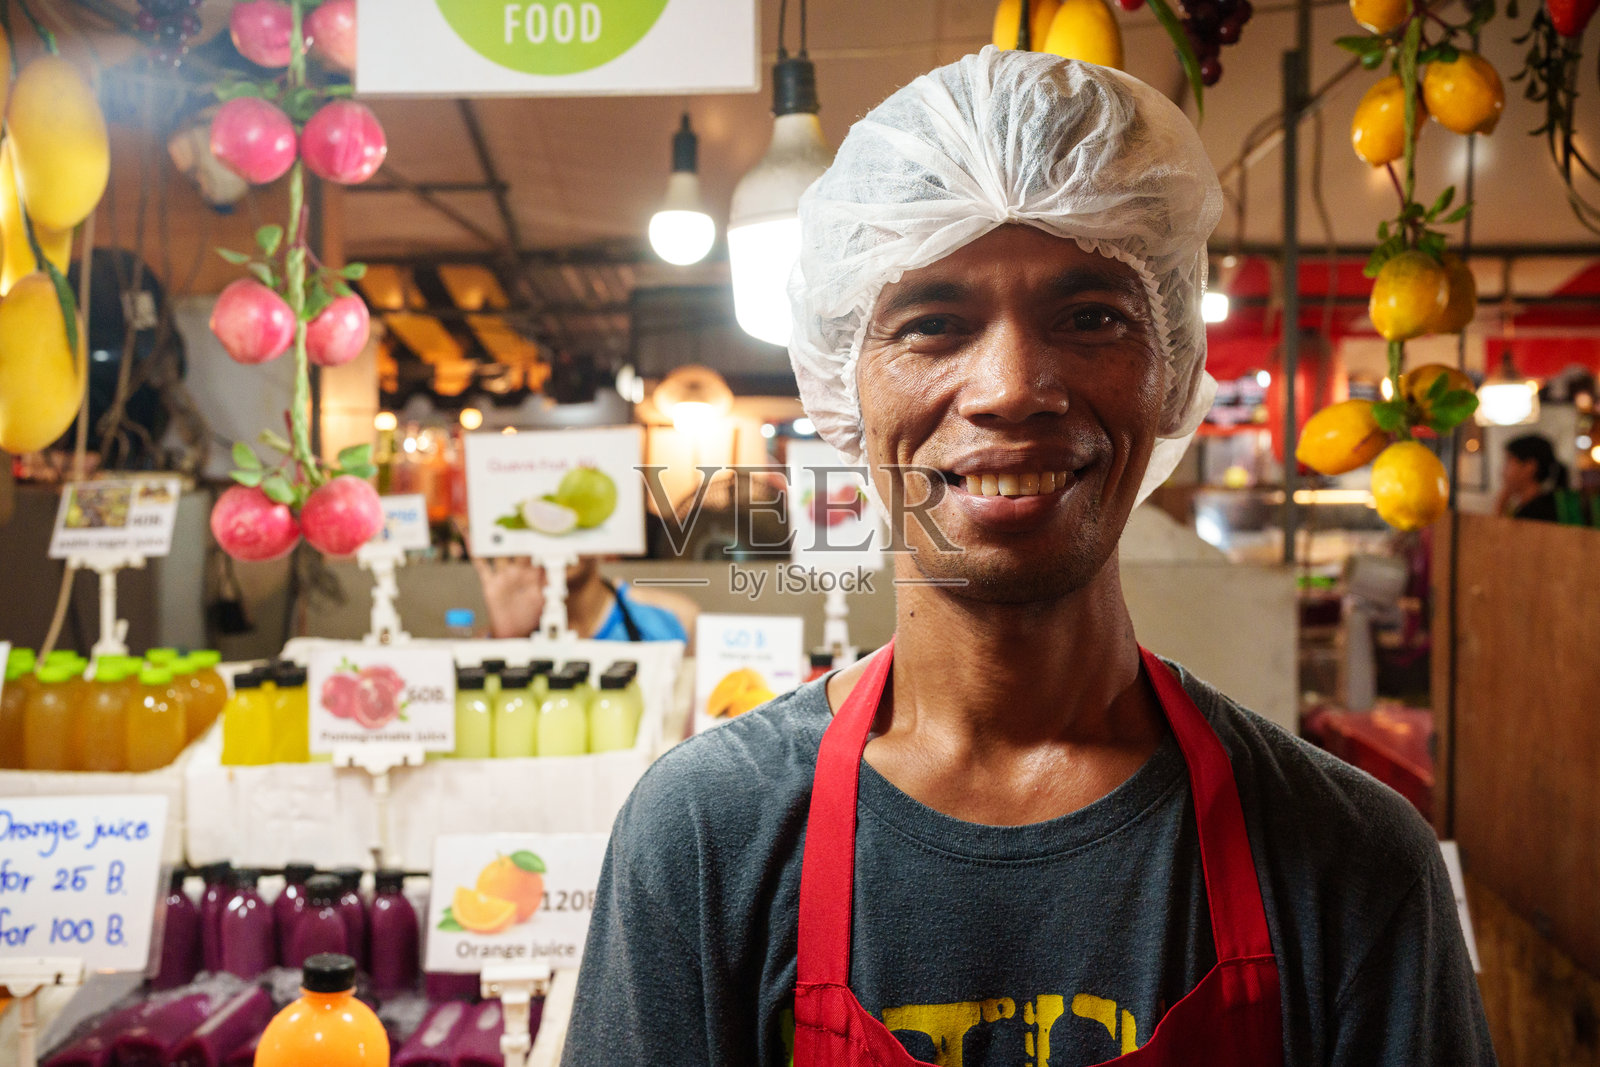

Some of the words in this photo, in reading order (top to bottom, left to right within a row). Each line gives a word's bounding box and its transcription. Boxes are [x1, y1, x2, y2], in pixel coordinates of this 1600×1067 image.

[504, 2, 602, 44] FOOD
[84, 816, 150, 849] juice
[0, 858, 34, 894] for
[52, 865, 95, 892] 25
[50, 917, 95, 944] 100
[456, 940, 526, 959] Orange
[532, 939, 576, 958] juice
